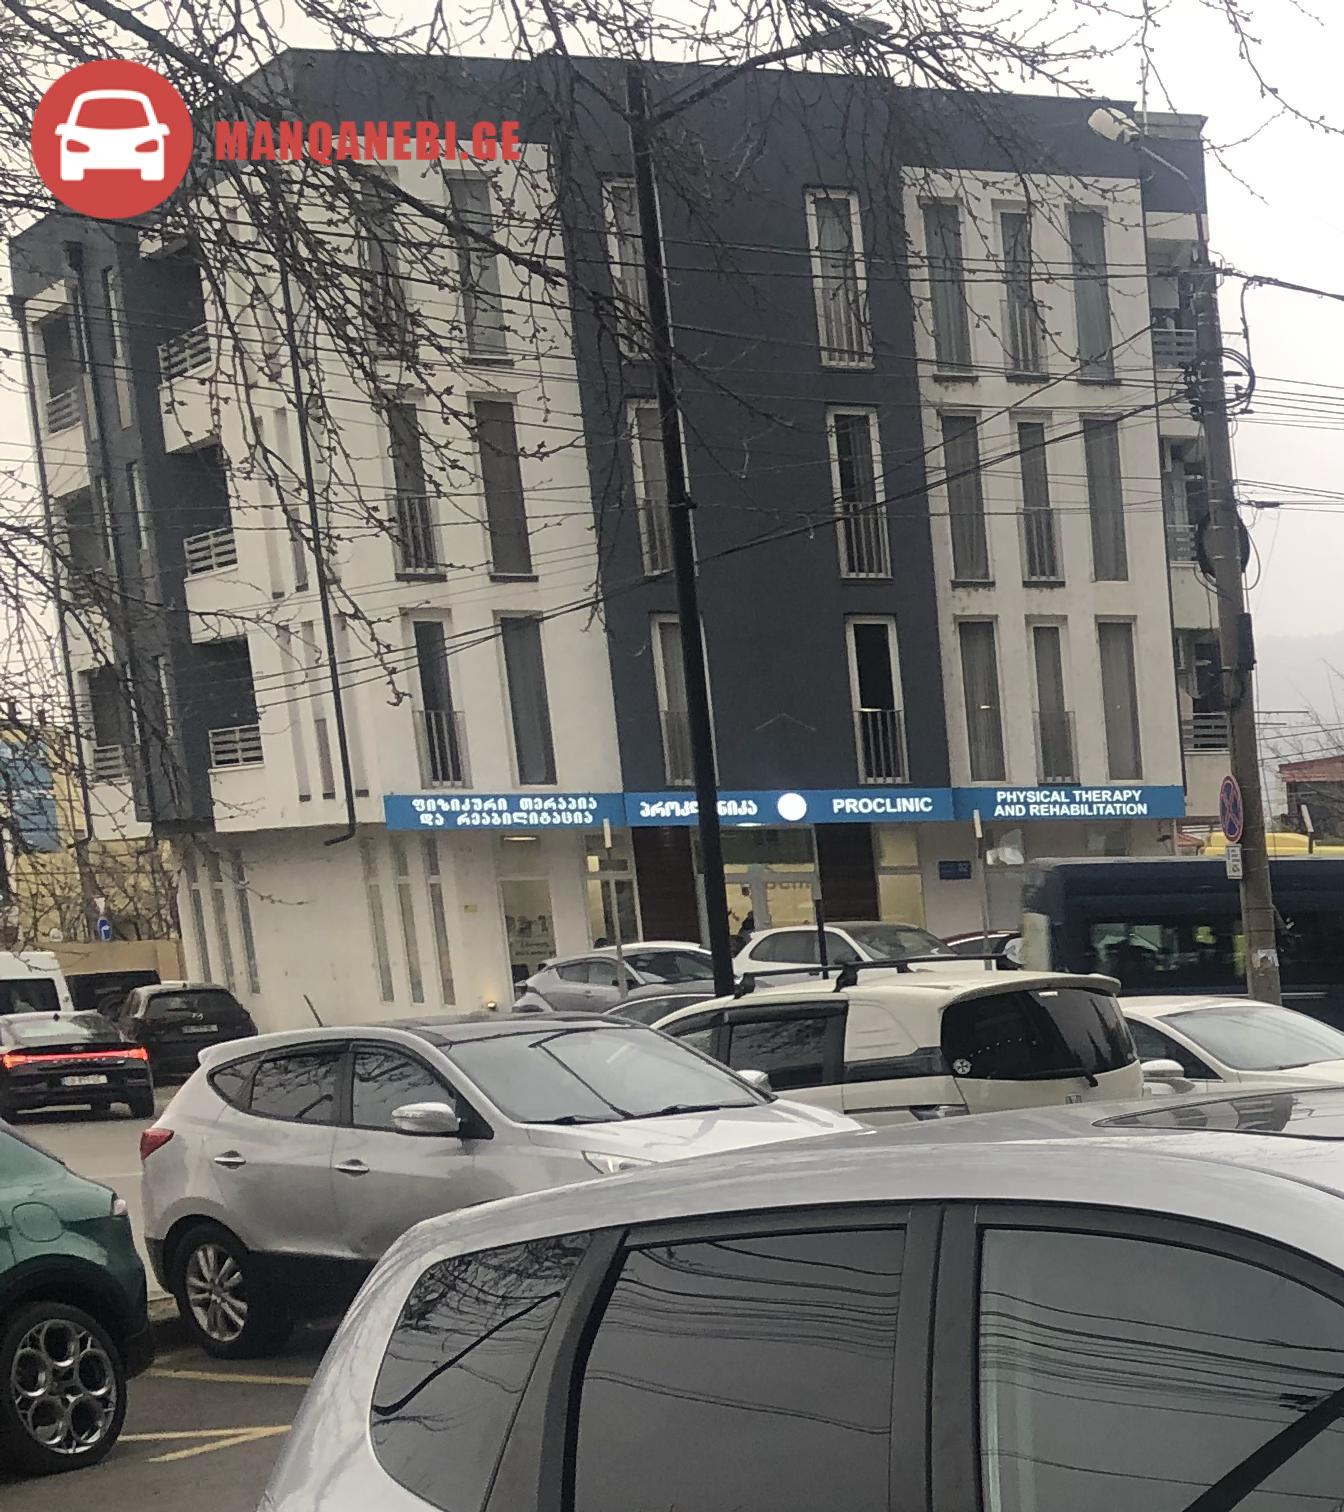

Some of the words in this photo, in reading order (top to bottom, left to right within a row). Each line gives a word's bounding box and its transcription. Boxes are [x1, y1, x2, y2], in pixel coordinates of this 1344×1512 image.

[411, 797, 508, 813] ფიზიკური
[519, 796, 598, 812] თერაპია
[996, 790, 1070, 804] PHYSICAL
[1073, 789, 1143, 803] THERAPY
[832, 796, 933, 815] PROCLINIC
[993, 803, 1026, 817] AND
[1029, 802, 1149, 817] REHABILITATION
[419, 812, 445, 827] და
[457, 811, 594, 826] რეაბილიტაცია
